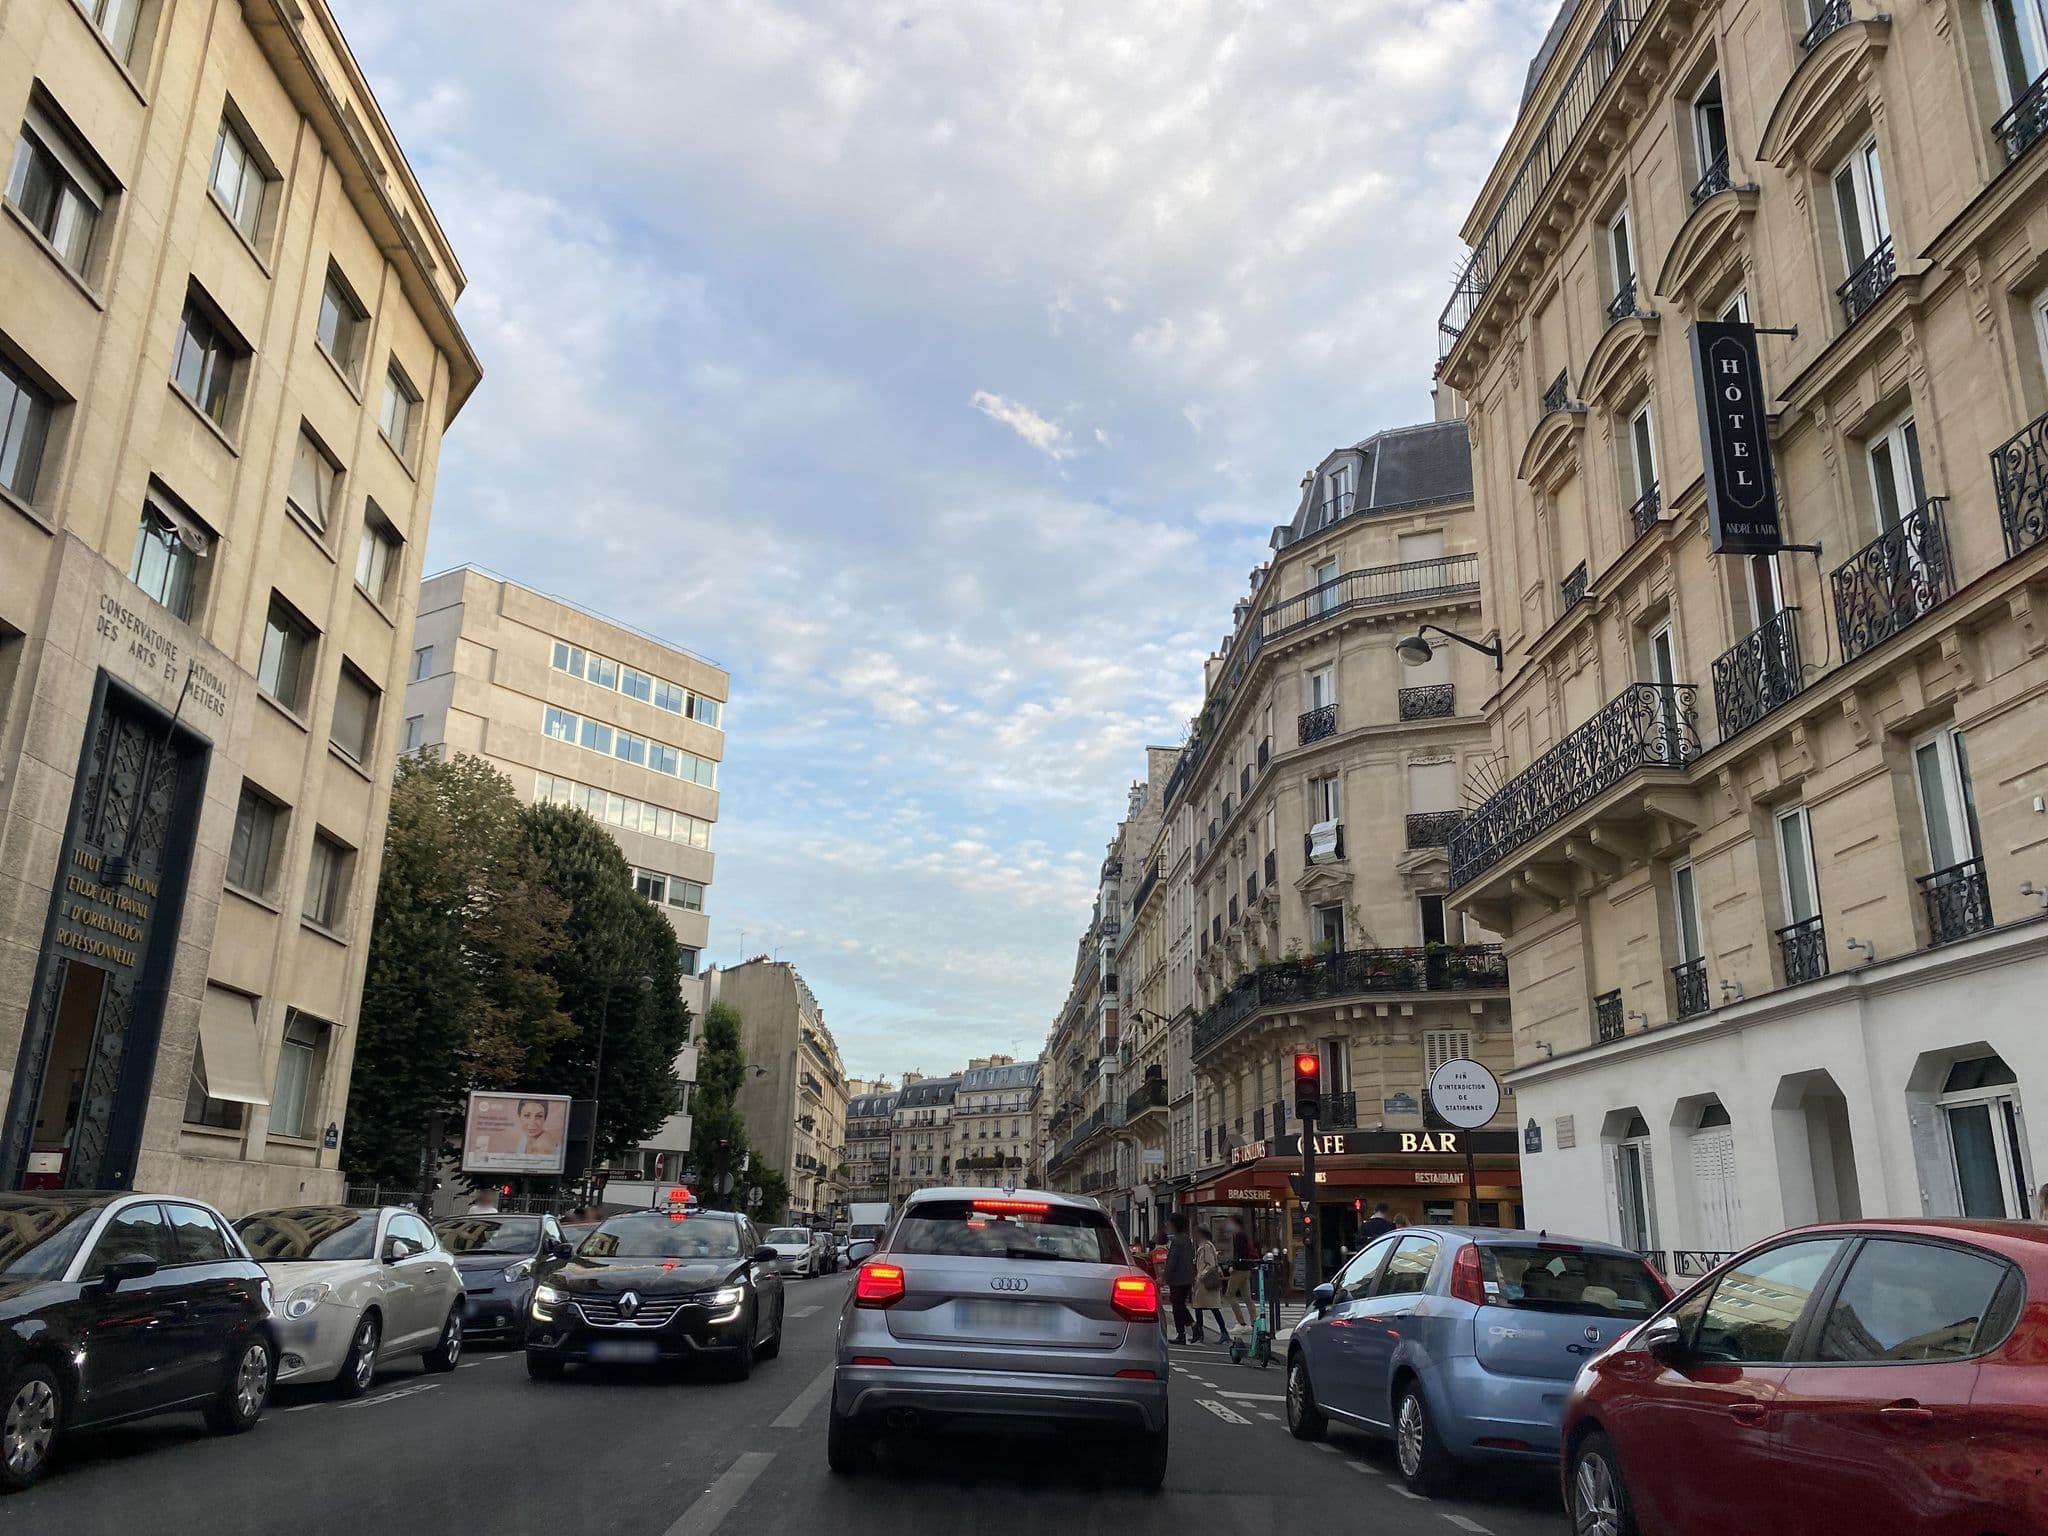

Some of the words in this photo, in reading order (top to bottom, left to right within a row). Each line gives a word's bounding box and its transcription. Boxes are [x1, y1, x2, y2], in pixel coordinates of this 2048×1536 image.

[1720, 359, 1753, 486] HÔTEL
[96, 615, 119, 642] DES
[128, 640, 157, 668] ARTS
[163, 663, 178, 682] ET
[99, 593, 178, 661] CONSERVATOIRE
[188, 658, 227, 699] NATIONAL
[127, 871, 159, 898] ATIONAL
[99, 888, 114, 906] DU
[115, 894, 149, 920] TRAVAIL
[71, 904, 143, 942] D'ORIENTATION
[55, 927, 136, 968] ROFESSIONNELLE
[1400, 1132, 1457, 1153] BAR
[1228, 1189, 1271, 1200] BRASSERIE
[1415, 1172, 1464, 1184] RESTAURANT
